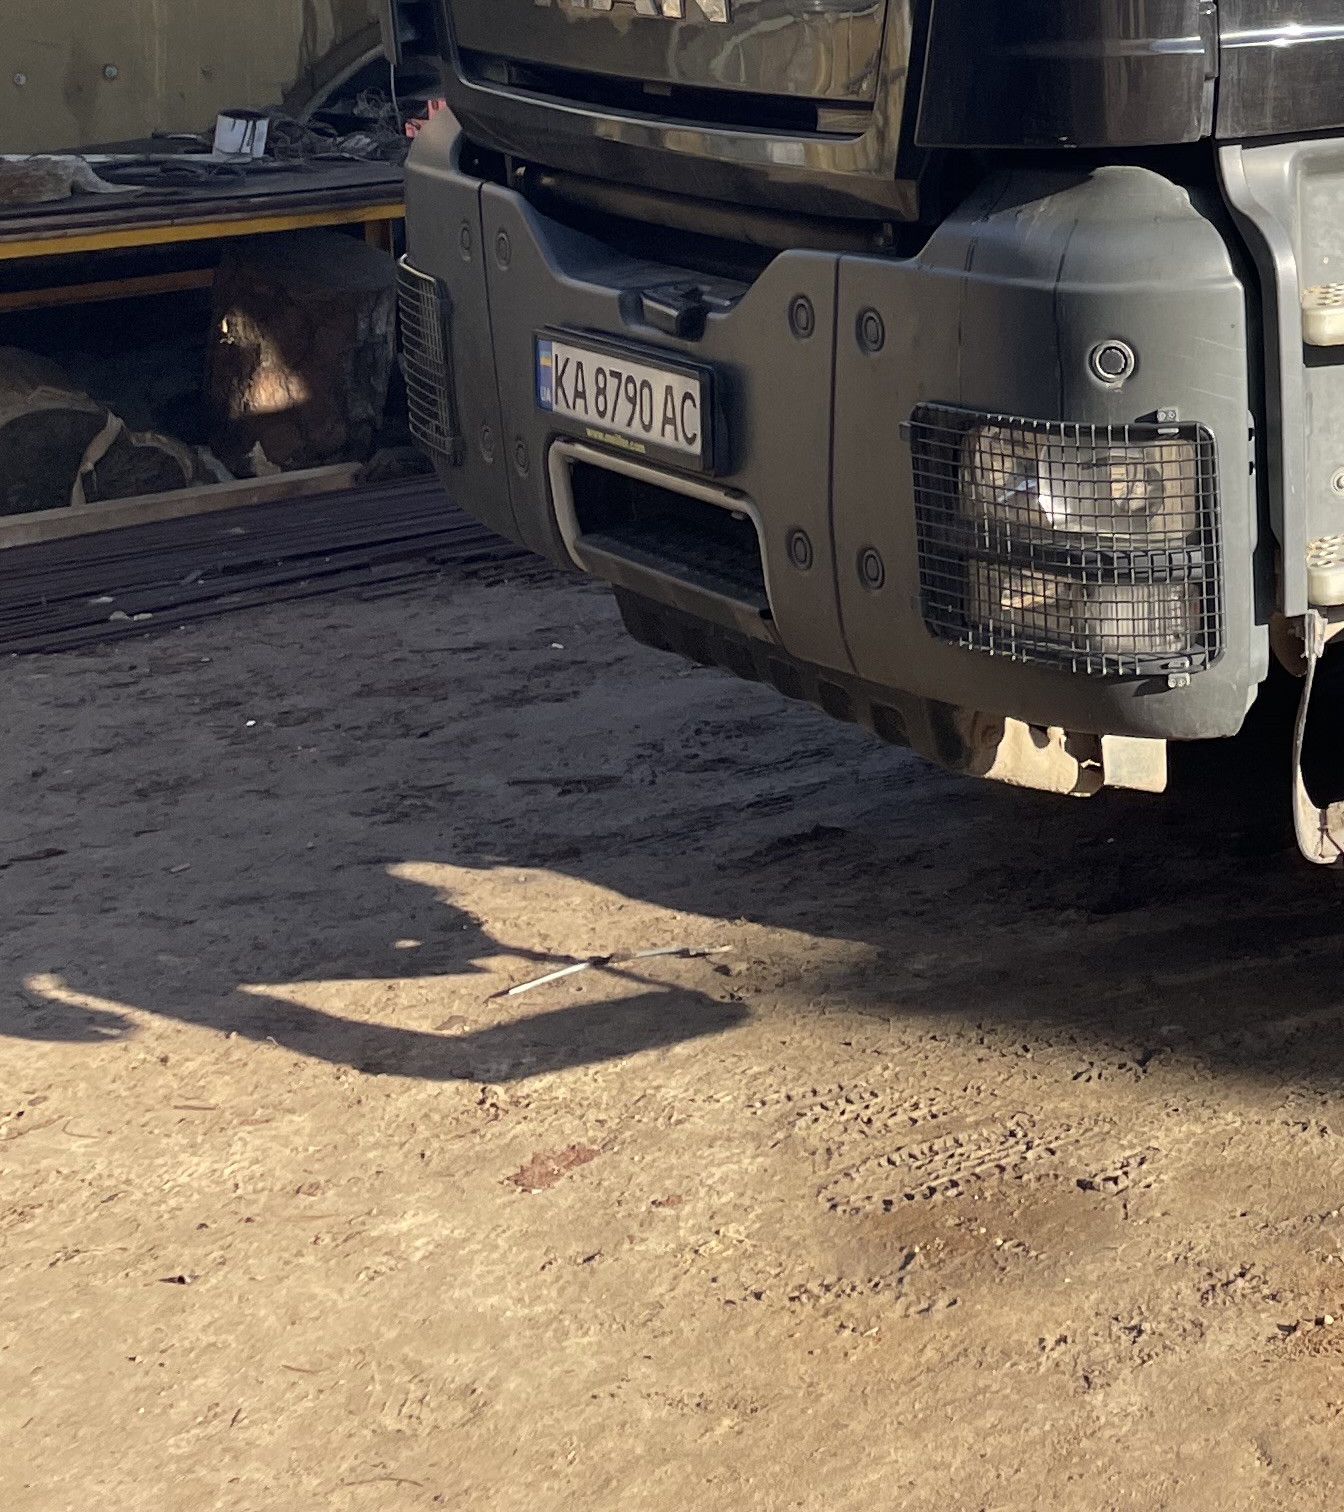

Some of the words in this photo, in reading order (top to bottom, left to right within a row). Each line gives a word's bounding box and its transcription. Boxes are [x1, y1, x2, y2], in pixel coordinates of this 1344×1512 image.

[554, 353, 589, 415] KA
[594, 366, 654, 433] 8790
[661, 384, 697, 446] AC
